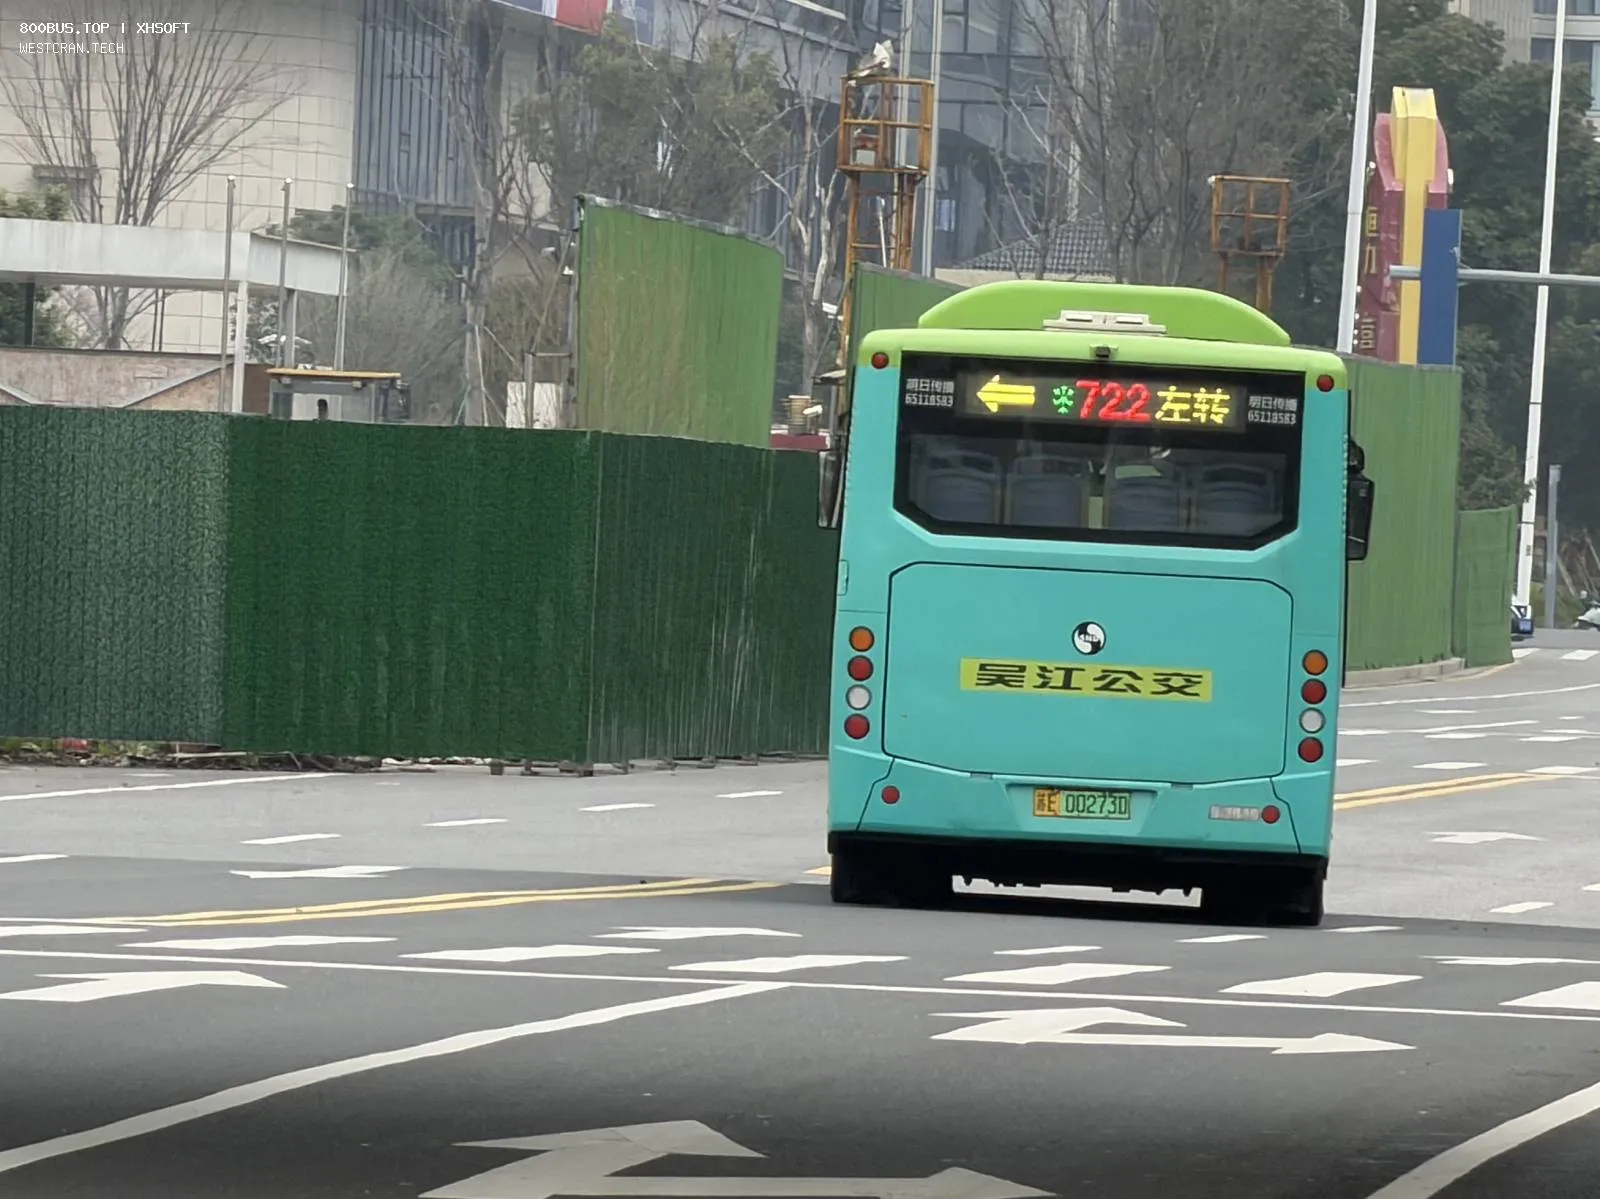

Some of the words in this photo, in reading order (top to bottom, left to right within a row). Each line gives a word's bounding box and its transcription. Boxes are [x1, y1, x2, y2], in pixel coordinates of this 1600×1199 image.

[1075, 379, 1151, 421] 722
[1155, 384, 1231, 424] 左转
[975, 662, 1204, 697] 吴江公交
